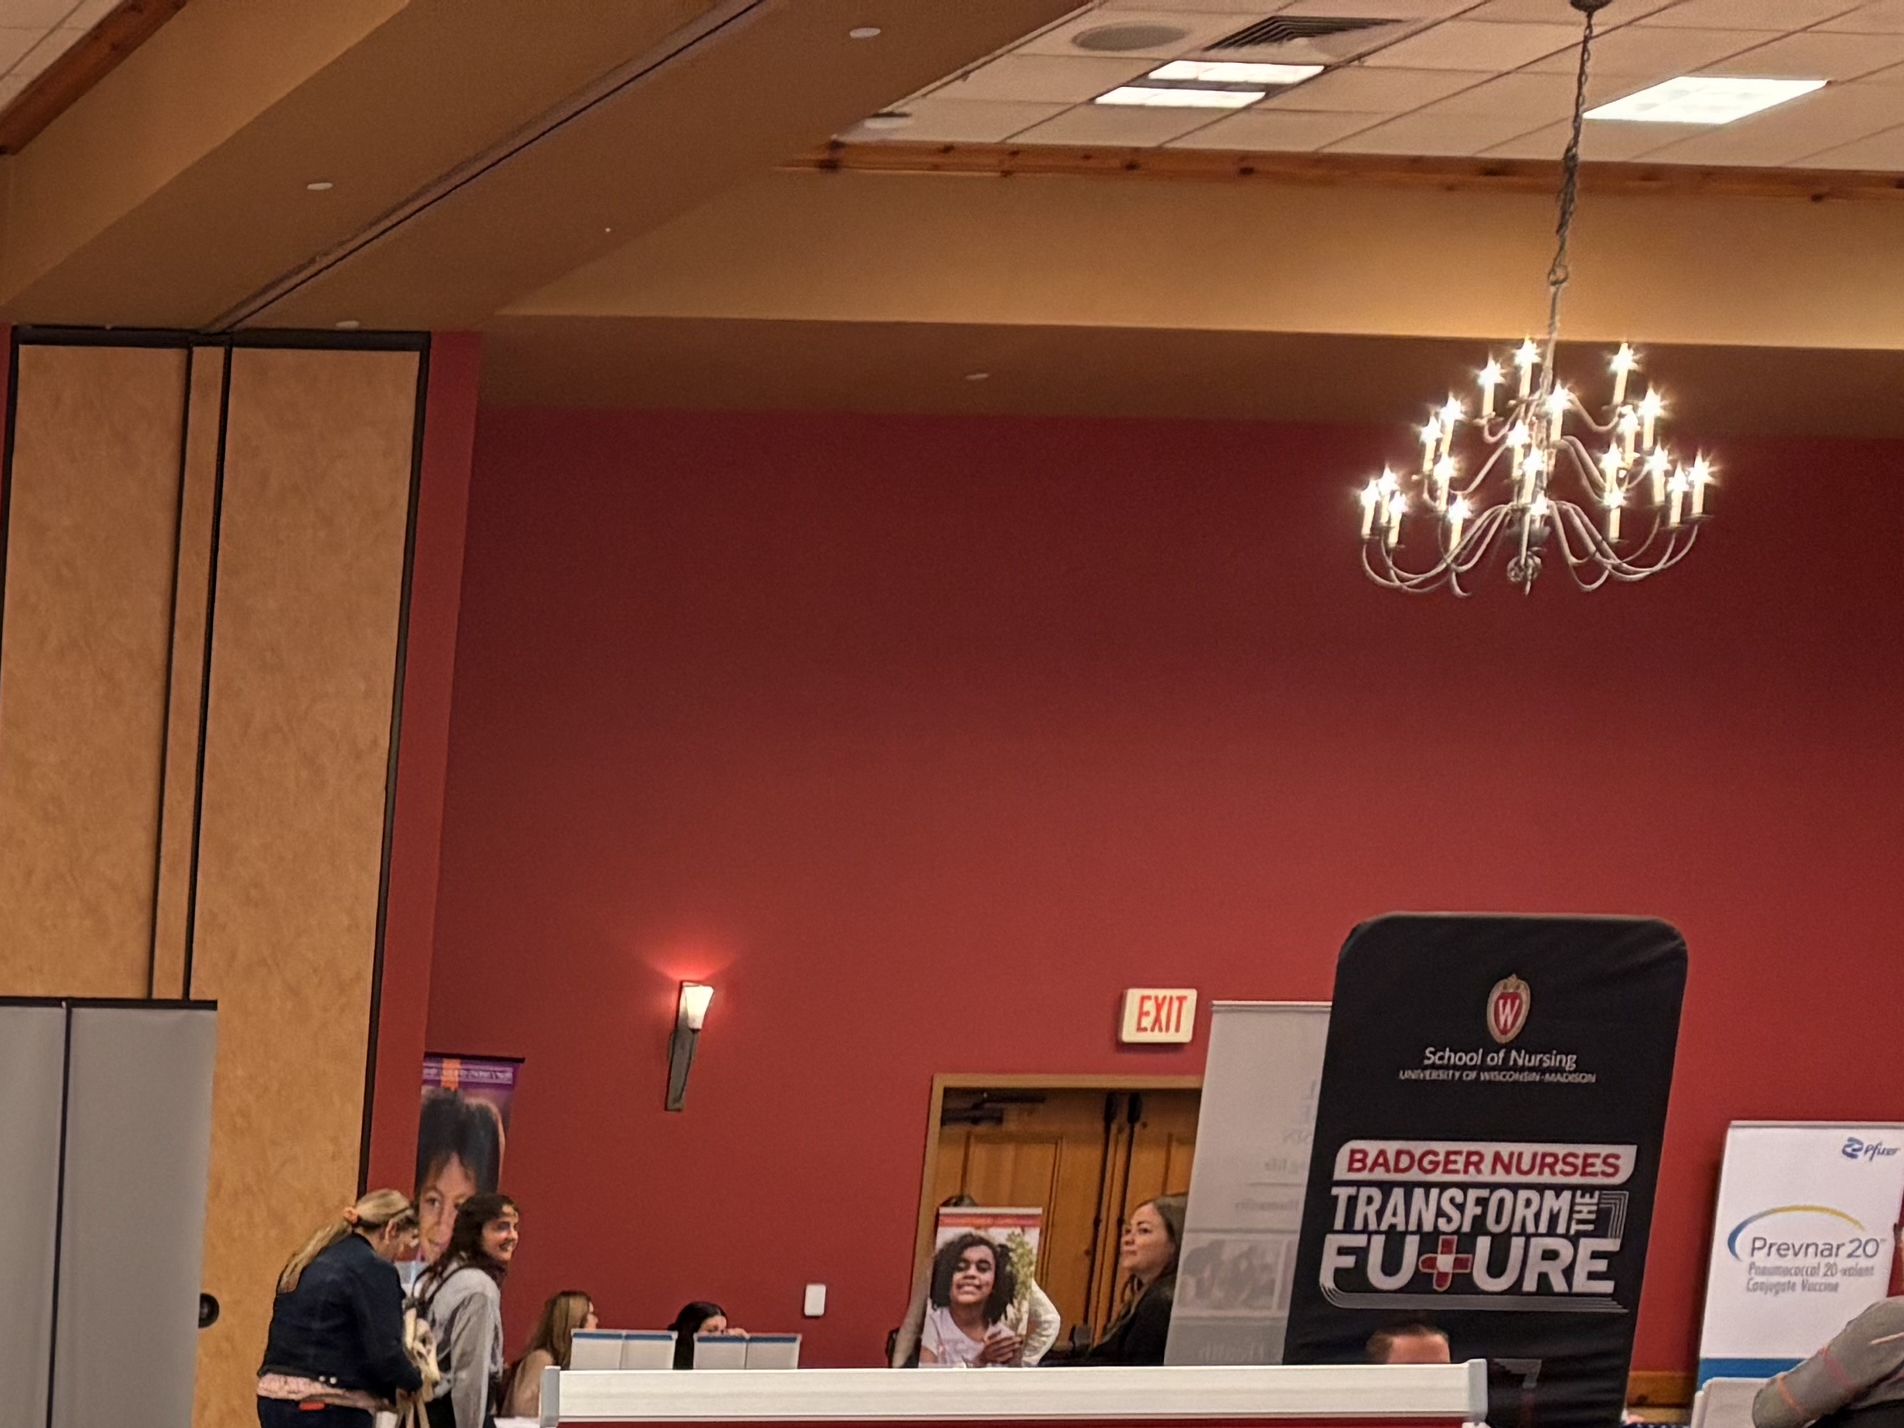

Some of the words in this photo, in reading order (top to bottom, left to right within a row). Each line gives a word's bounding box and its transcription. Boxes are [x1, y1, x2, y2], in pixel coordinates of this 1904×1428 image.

[1136, 995, 1186, 1034] EXIT
[1496, 998, 1520, 1029] W
[1424, 1047, 1482, 1065] School
[1486, 1048, 1505, 1065] of
[1509, 1049, 1576, 1071] Nursing
[1399, 1069, 1460, 1079] UNIVERSITY
[1462, 1070, 1477, 1080] OF
[1480, 1071, 1596, 1083] WISCONSIN-MADISON
[1347, 1148, 1484, 1174] BADGER
[1490, 1150, 1620, 1177] NURSES
[1331, 1186, 1571, 1234] TRANSFORM
[1572, 1189, 1599, 1233] THE
[1751, 1236, 1845, 1258] Prevnar
[1748, 1262, 1820, 1277] Pneumococcal
[1746, 1279, 1797, 1295] Conjugate
[1801, 1280, 1839, 1293] Vaccine
